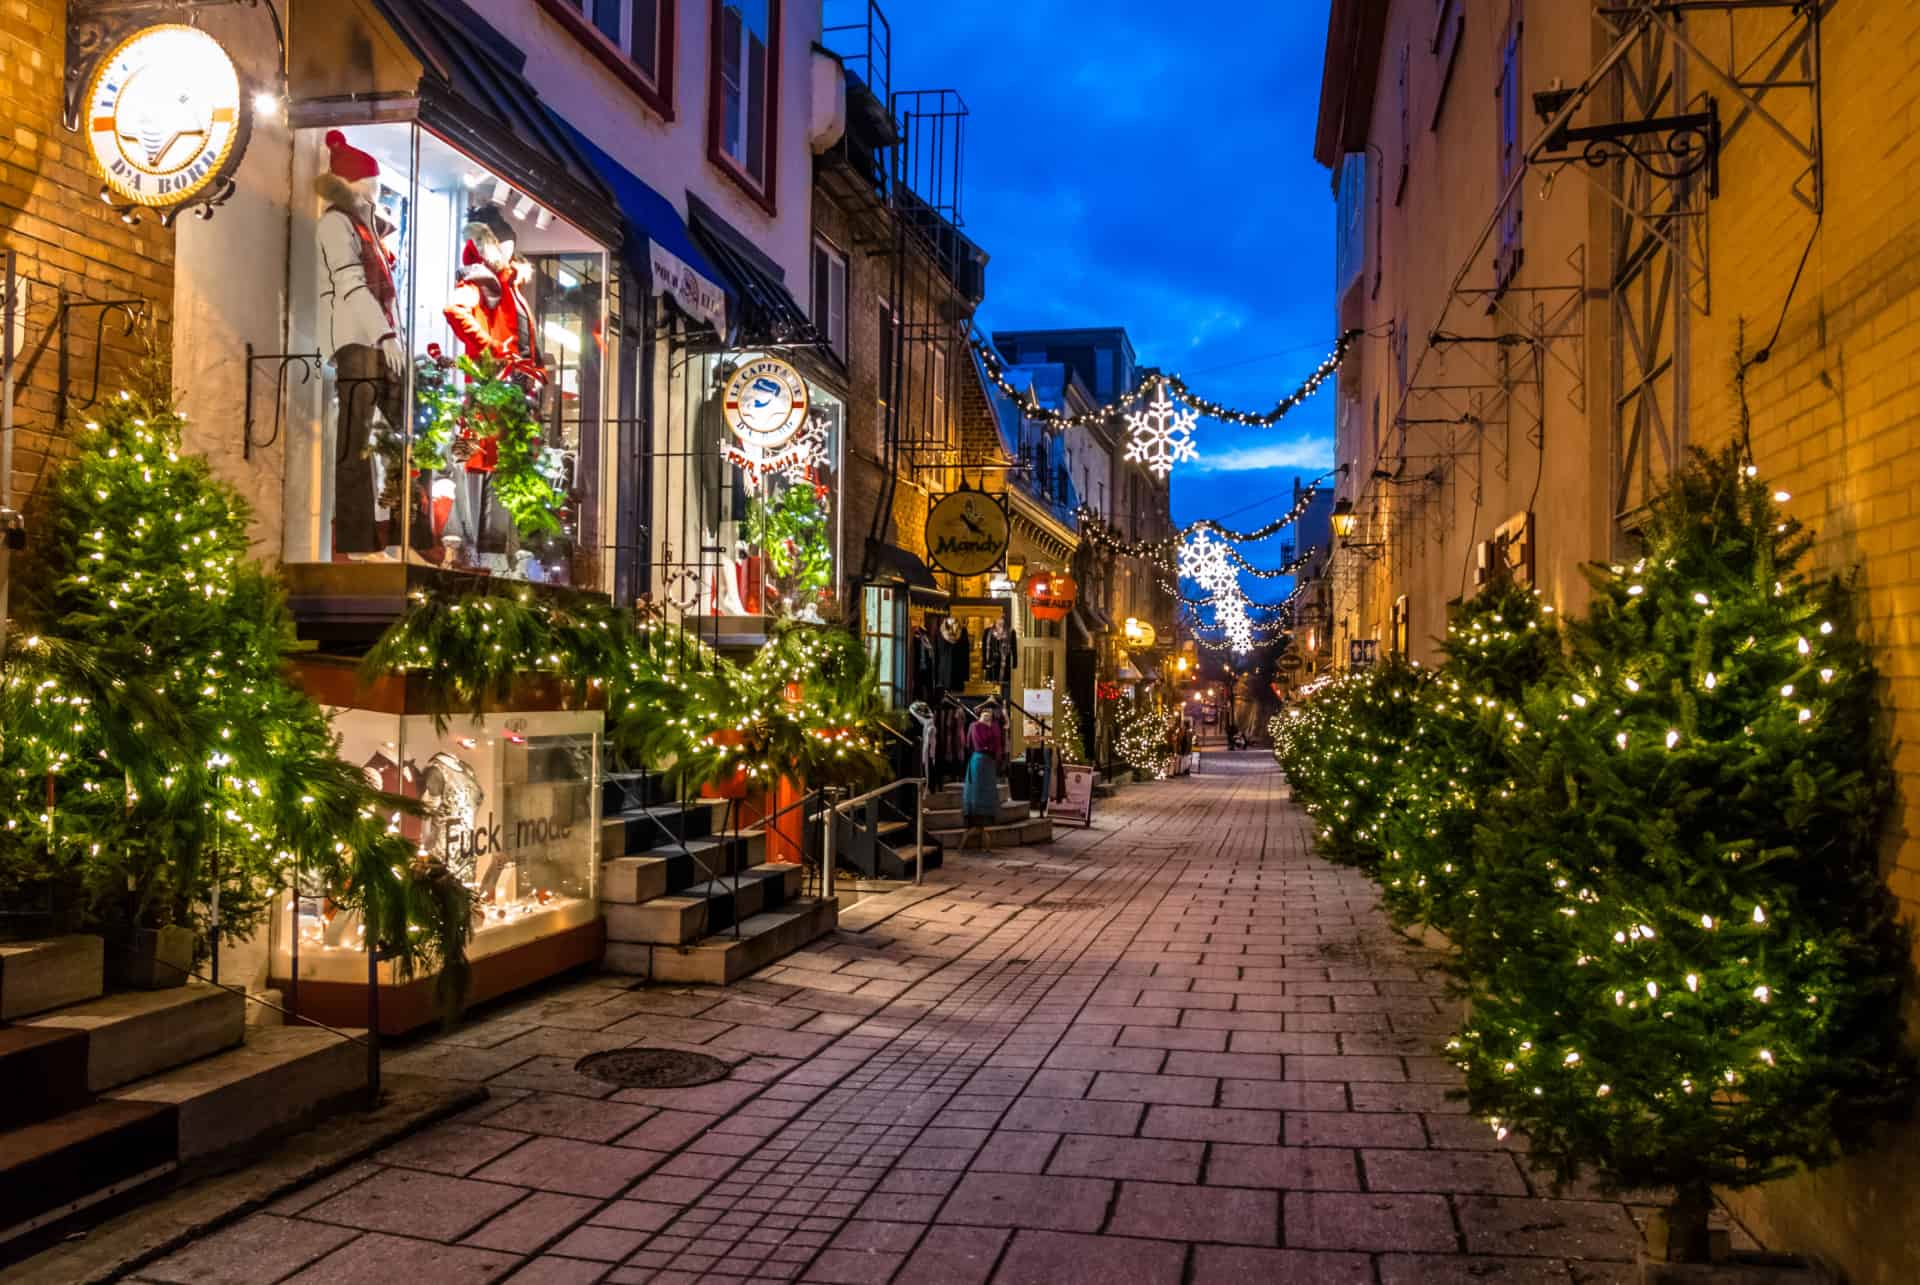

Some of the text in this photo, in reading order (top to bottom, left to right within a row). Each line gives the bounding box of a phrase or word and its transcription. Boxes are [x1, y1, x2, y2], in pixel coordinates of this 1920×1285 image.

[157, 150, 217, 194] BORD
[741, 362, 802, 397] CAPITAE
[445, 811, 501, 863] Fuck
